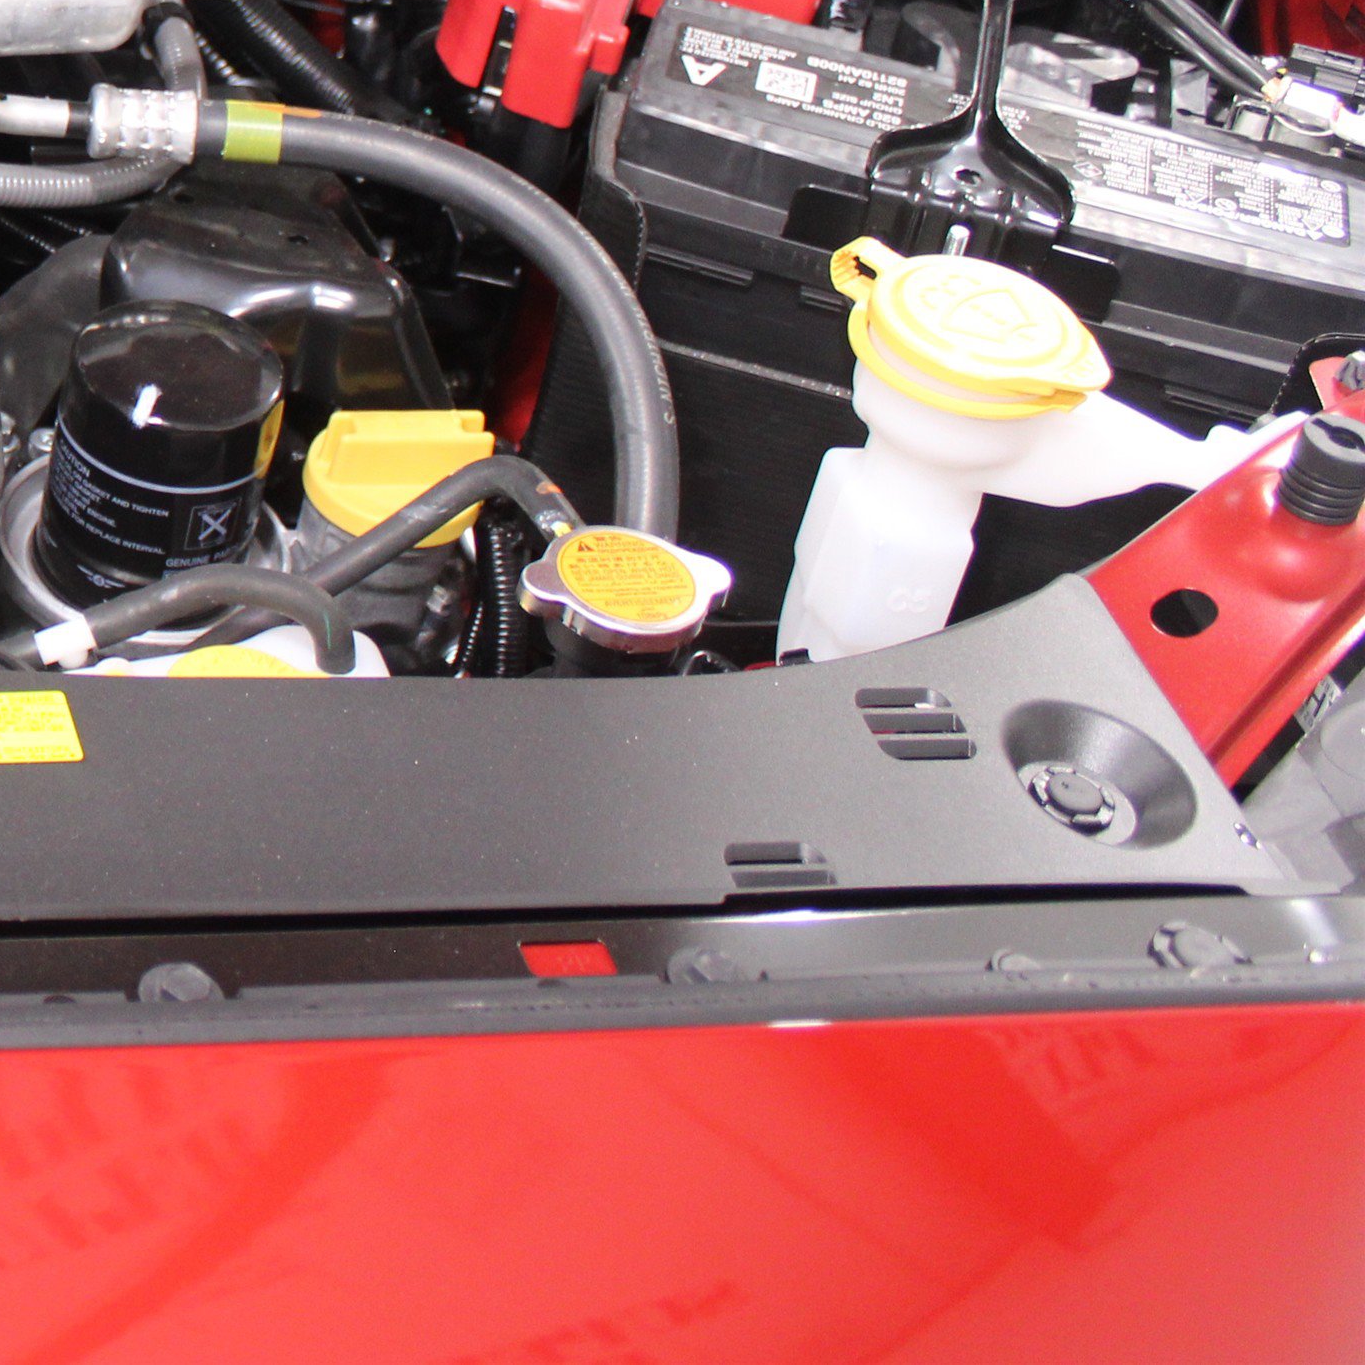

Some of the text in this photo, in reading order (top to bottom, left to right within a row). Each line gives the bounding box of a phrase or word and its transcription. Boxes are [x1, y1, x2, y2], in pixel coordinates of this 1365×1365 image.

[838, 74, 856, 84] AH
[766, 93, 800, 108] AMPS
[832, 91, 903, 115] GROUP SIZE
[872, 92, 904, 108] LN2
[802, 104, 864, 125] CRANKING
[822, 98, 902, 125] 620 AMPS
[131, 503, 169, 517] TIGHTEN
[85, 523, 121, 545] REPLACE
[122, 540, 166, 555] INTERVAL.
[165, 554, 210, 568] GENUINE
